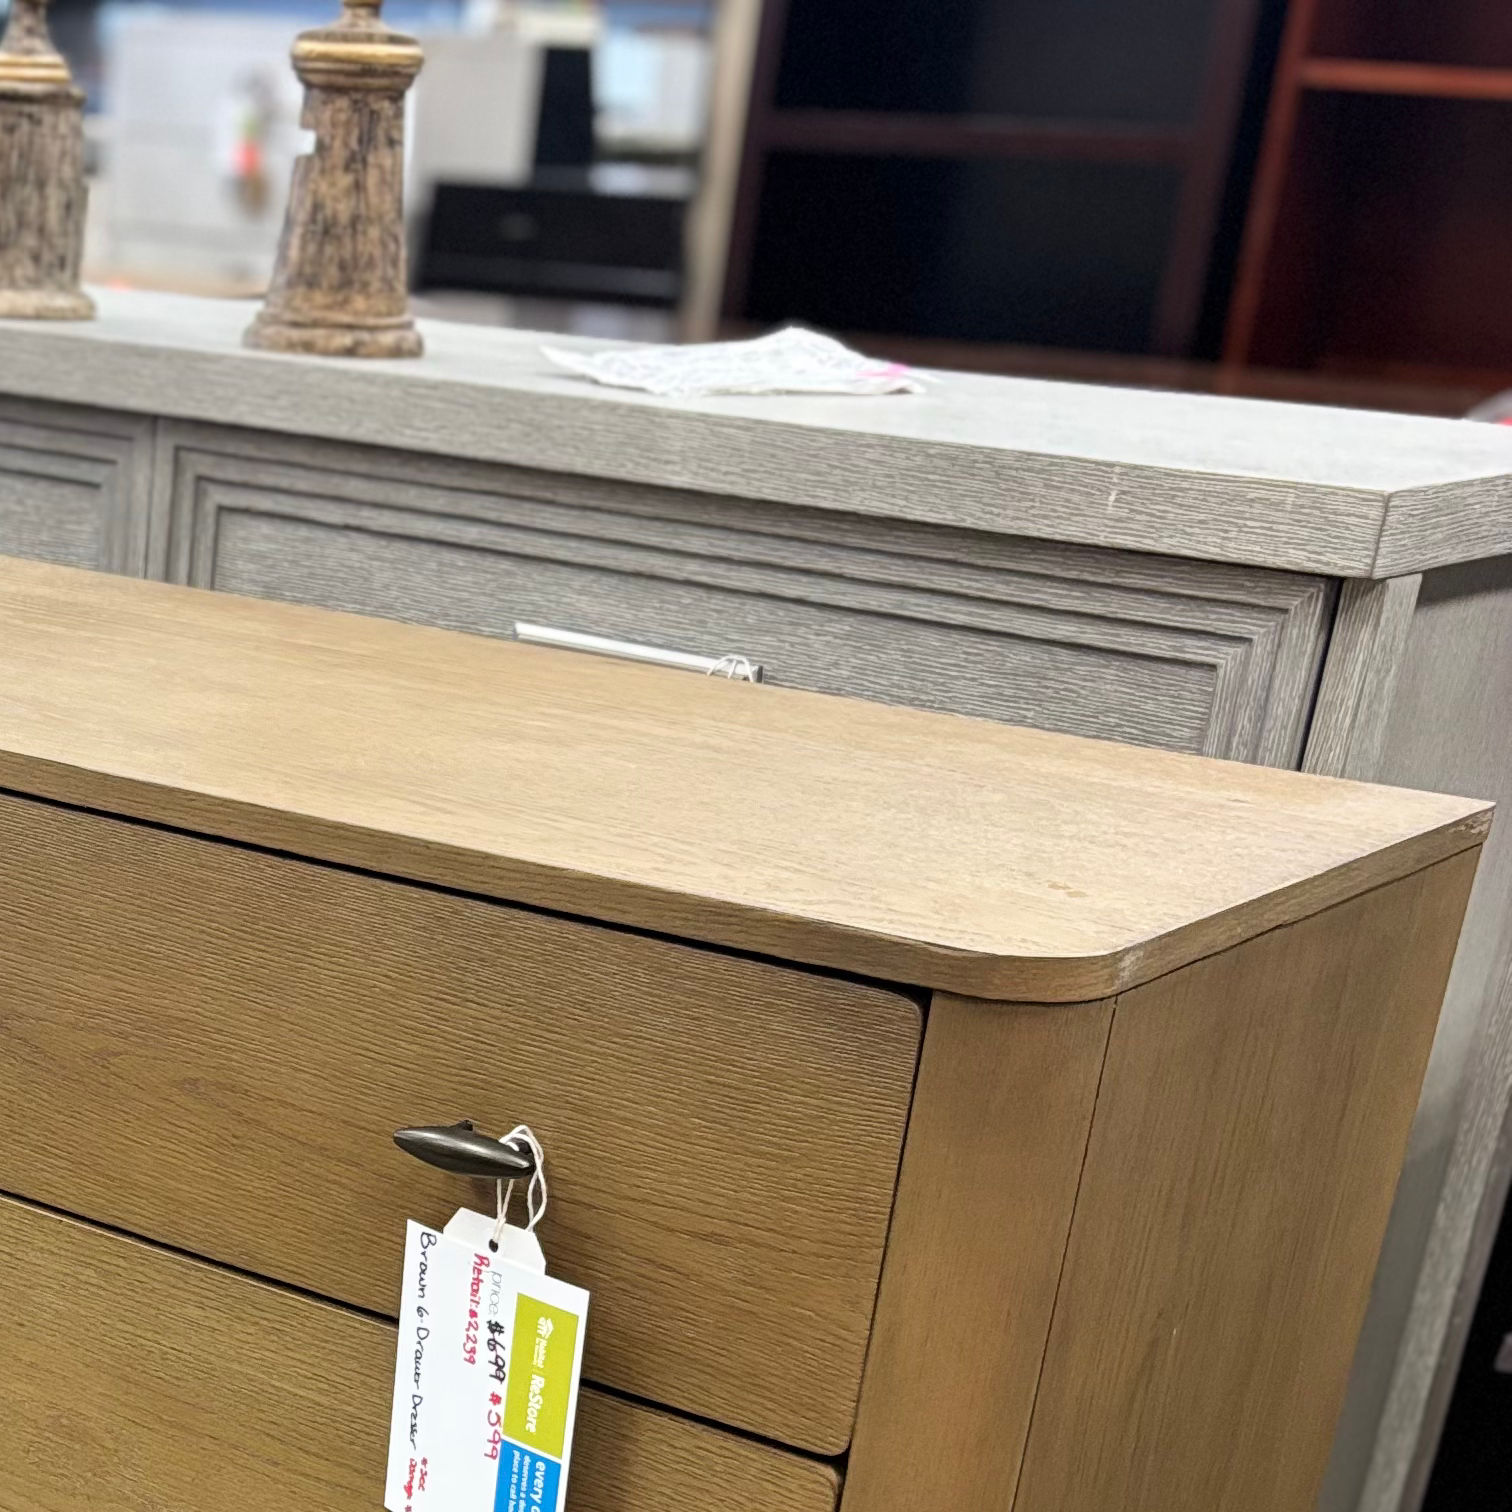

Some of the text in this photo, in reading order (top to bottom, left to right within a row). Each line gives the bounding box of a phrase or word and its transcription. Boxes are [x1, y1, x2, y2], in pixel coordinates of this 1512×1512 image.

[418, 1231, 437, 1299] Brown
[526, 1373, 545, 1433] ReStore
[529, 1461, 546, 1504] every
